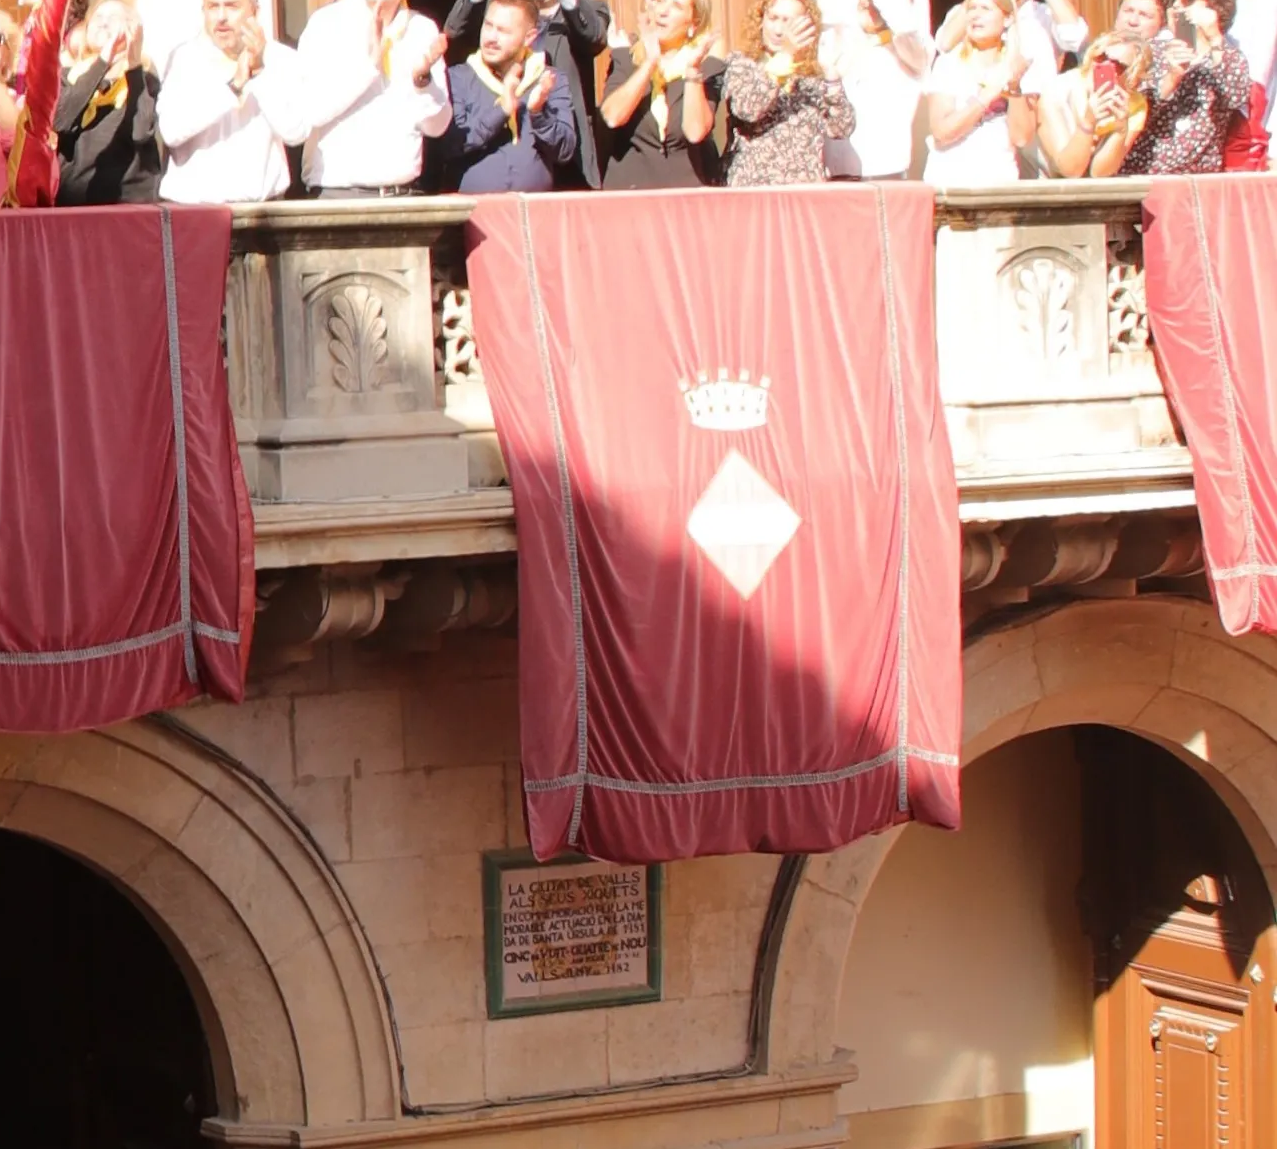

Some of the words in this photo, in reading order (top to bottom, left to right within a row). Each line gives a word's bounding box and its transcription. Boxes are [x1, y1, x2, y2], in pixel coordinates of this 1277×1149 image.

[508, 883, 525, 896] LA
[576, 877, 590, 888] DE
[598, 871, 640, 886] VALLS
[509, 896, 535, 909] ALS
[540, 892, 574, 905] SEUS
[616, 902, 629, 912] LA
[613, 913, 625, 923] LA
[504, 937, 516, 947] DA
[519, 935, 530, 946] DE
[532, 932, 564, 944] SANTA
[504, 950, 530, 964] CINC
[620, 937, 646, 951] NOU
